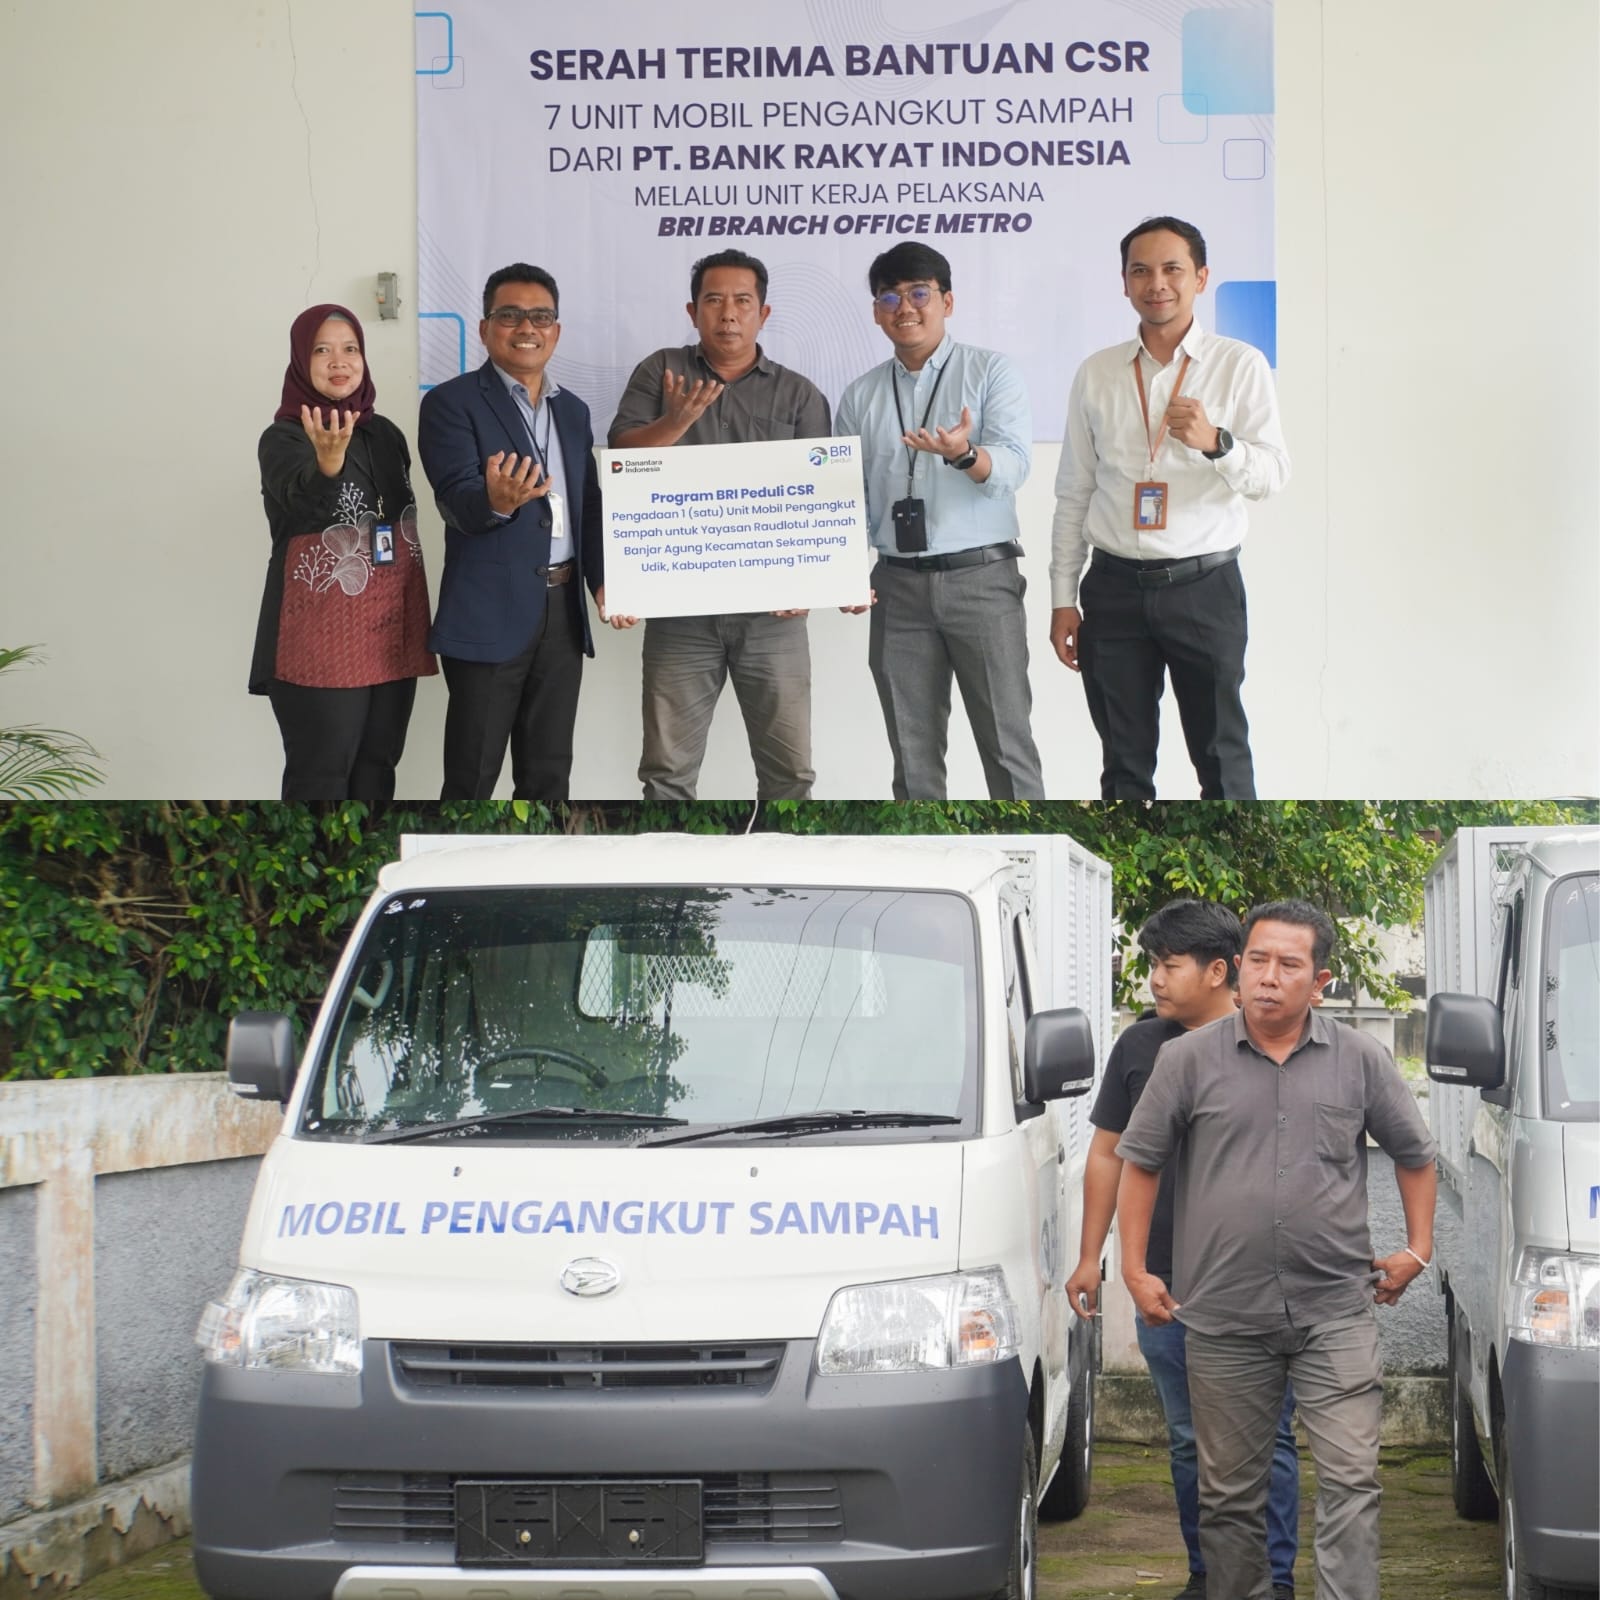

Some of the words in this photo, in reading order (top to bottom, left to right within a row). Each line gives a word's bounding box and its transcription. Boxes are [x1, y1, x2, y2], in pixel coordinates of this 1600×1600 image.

[530, 49, 665, 80] SERAH
[676, 46, 834, 78] TERIMA
[846, 43, 1053, 76] BANTUAN
[1065, 41, 1149, 72] CSR
[545, 105, 560, 129] 7
[572, 104, 643, 129] UNIT
[654, 103, 752, 128] MOBIL
[764, 99, 985, 127] PENGANGKUT
[996, 98, 1132, 124] SAMPAH
[550, 147, 621, 172] DARI
[632, 145, 682, 170] PT.
[690, 144, 785, 170] BANK
[795, 143, 933, 169] RAKYAT
[943, 140, 1130, 167] INDONESIA
[635, 185, 737, 206] MELALUI
[747, 185, 804, 205] UNIT
[813, 184, 888, 204] KERJA
[898, 182, 1044, 203] PELAKSANA
[658, 216, 704, 236] BRI
[708, 215, 829, 236] BRANCH
[834, 214, 931, 234] OFFICE
[934, 213, 1032, 233] METRO
[830, 445, 851, 457] BRI
[625, 459, 662, 467] Danantara
[651, 491, 713, 505] Program
[716, 489, 738, 500] BRI
[741, 485, 784, 499] Peduli
[787, 484, 814, 496] CSR
[612, 510, 679, 523] Pengadaan
[682, 509, 685, 518] 1
[689, 506, 723, 519] (satu)
[727, 505, 749, 515] Unit
[752, 504, 782, 514] Mobil
[785, 500, 855, 514] Pengangkut
[613, 528, 662, 540] Sampah
[665, 526, 698, 536] untuk
[701, 525, 751, 536] Yayasan
[754, 519, 809, 531] Raudlotul
[812, 516, 856, 528] Jannah
[624, 545, 662, 557] Banjar
[664, 545, 702, 556] Agung
[705, 541, 773, 552] Kecamatan
[776, 536, 846, 548] Sekampung
[642, 562, 669, 572] Udik,
[672, 560, 736, 572] Kabupaten
[739, 557, 794, 568] Lampung
[797, 554, 830, 563] Timur
[278, 1202, 406, 1237] MOBIL
[421, 1201, 734, 1234] PENGANGKUT
[750, 1202, 939, 1239] SAMPAH
